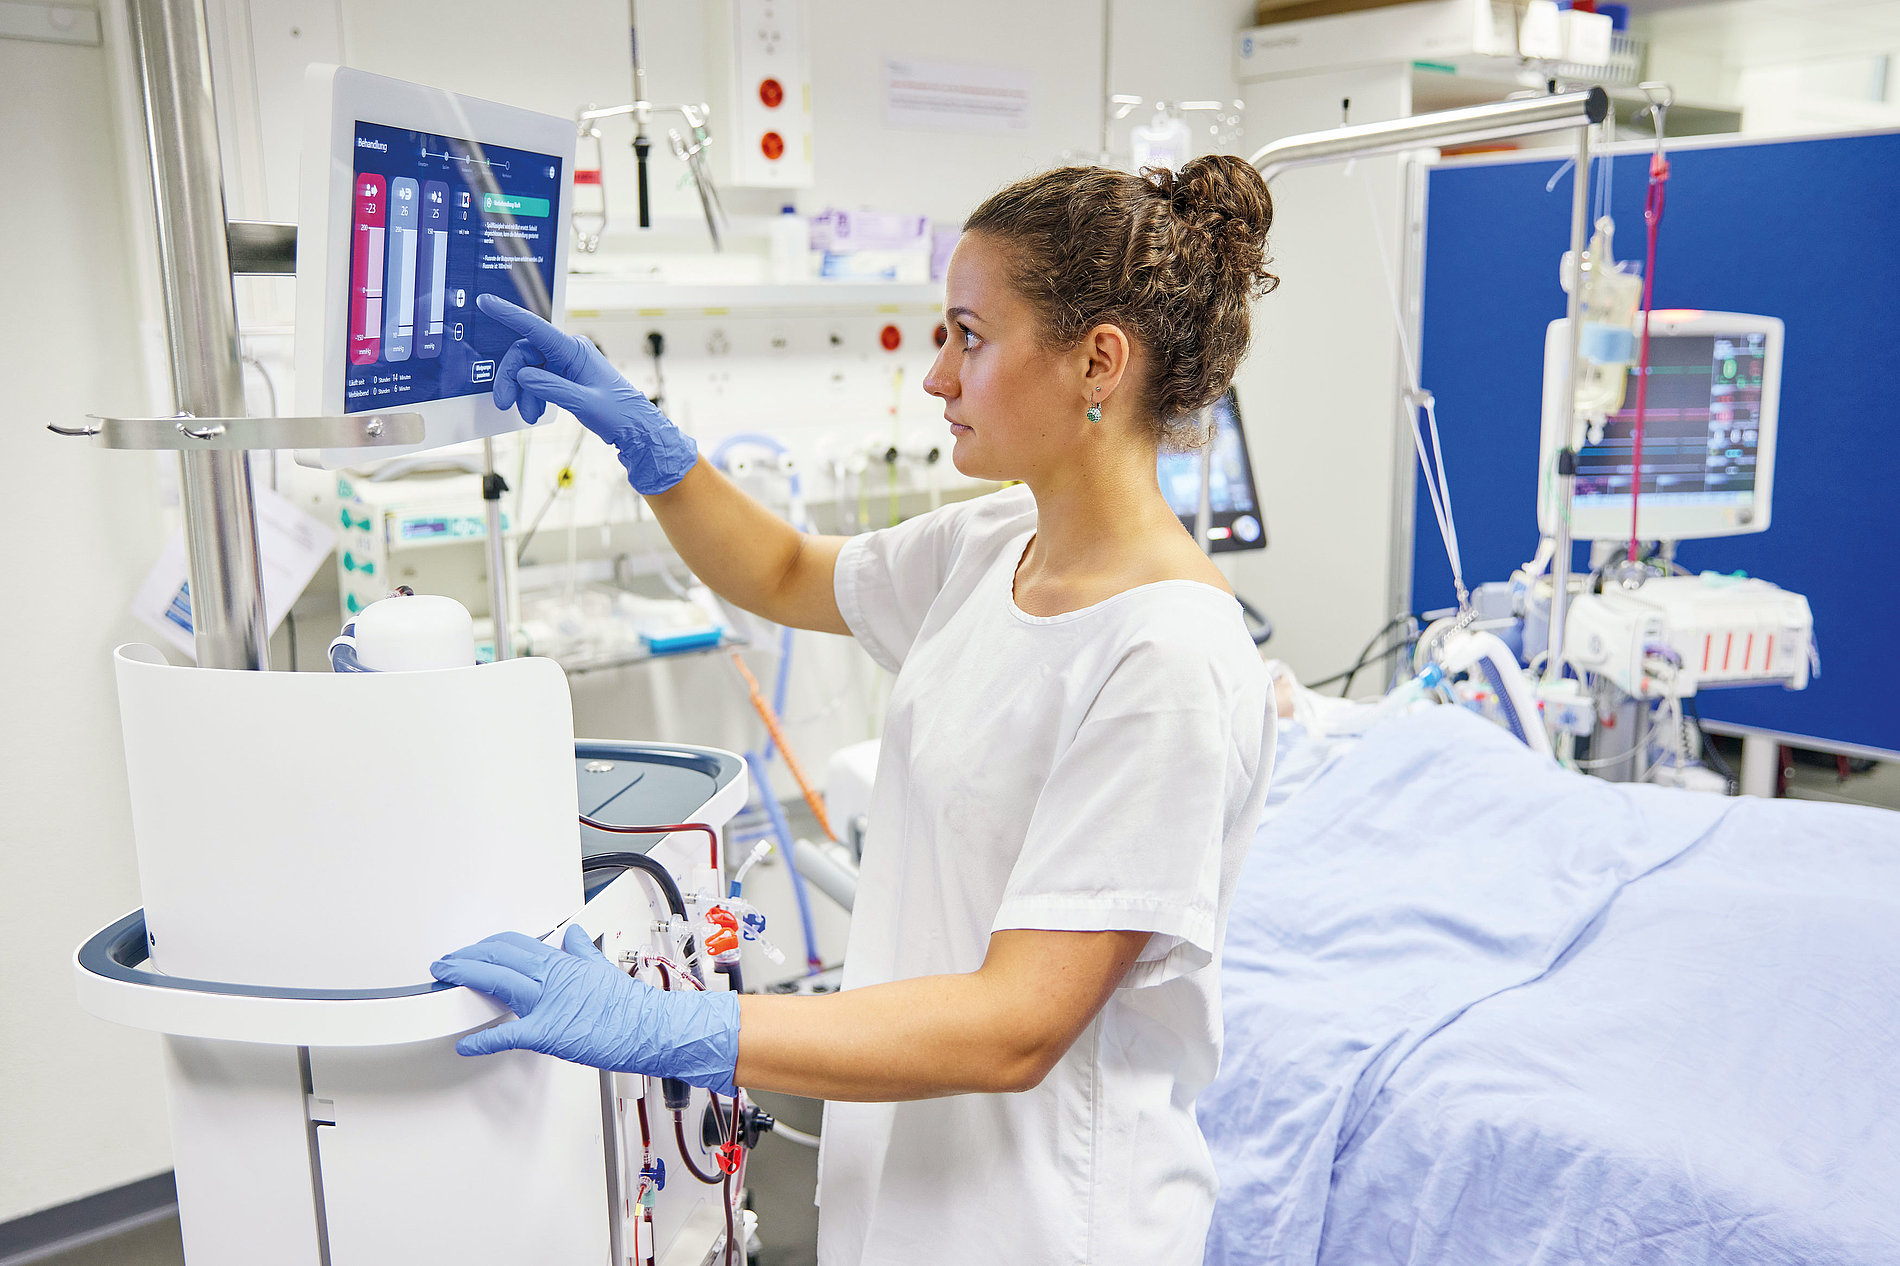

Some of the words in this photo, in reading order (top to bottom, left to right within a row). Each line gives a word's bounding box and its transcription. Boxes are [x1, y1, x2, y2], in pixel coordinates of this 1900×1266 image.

[358, 137, 388, 153] Behandlung
[365, 203, 376, 214] -23
[401, 205, 409, 216] 26
[432, 208, 440, 219] 25
[463, 211, 468, 221] 0
[358, 348, 371, 356] mmHg
[392, 345, 405, 353] mmHg
[373, 376, 378, 384] 0
[392, 373, 398, 382] 14
[373, 387, 378, 396] 0
[394, 384, 398, 393] 6
